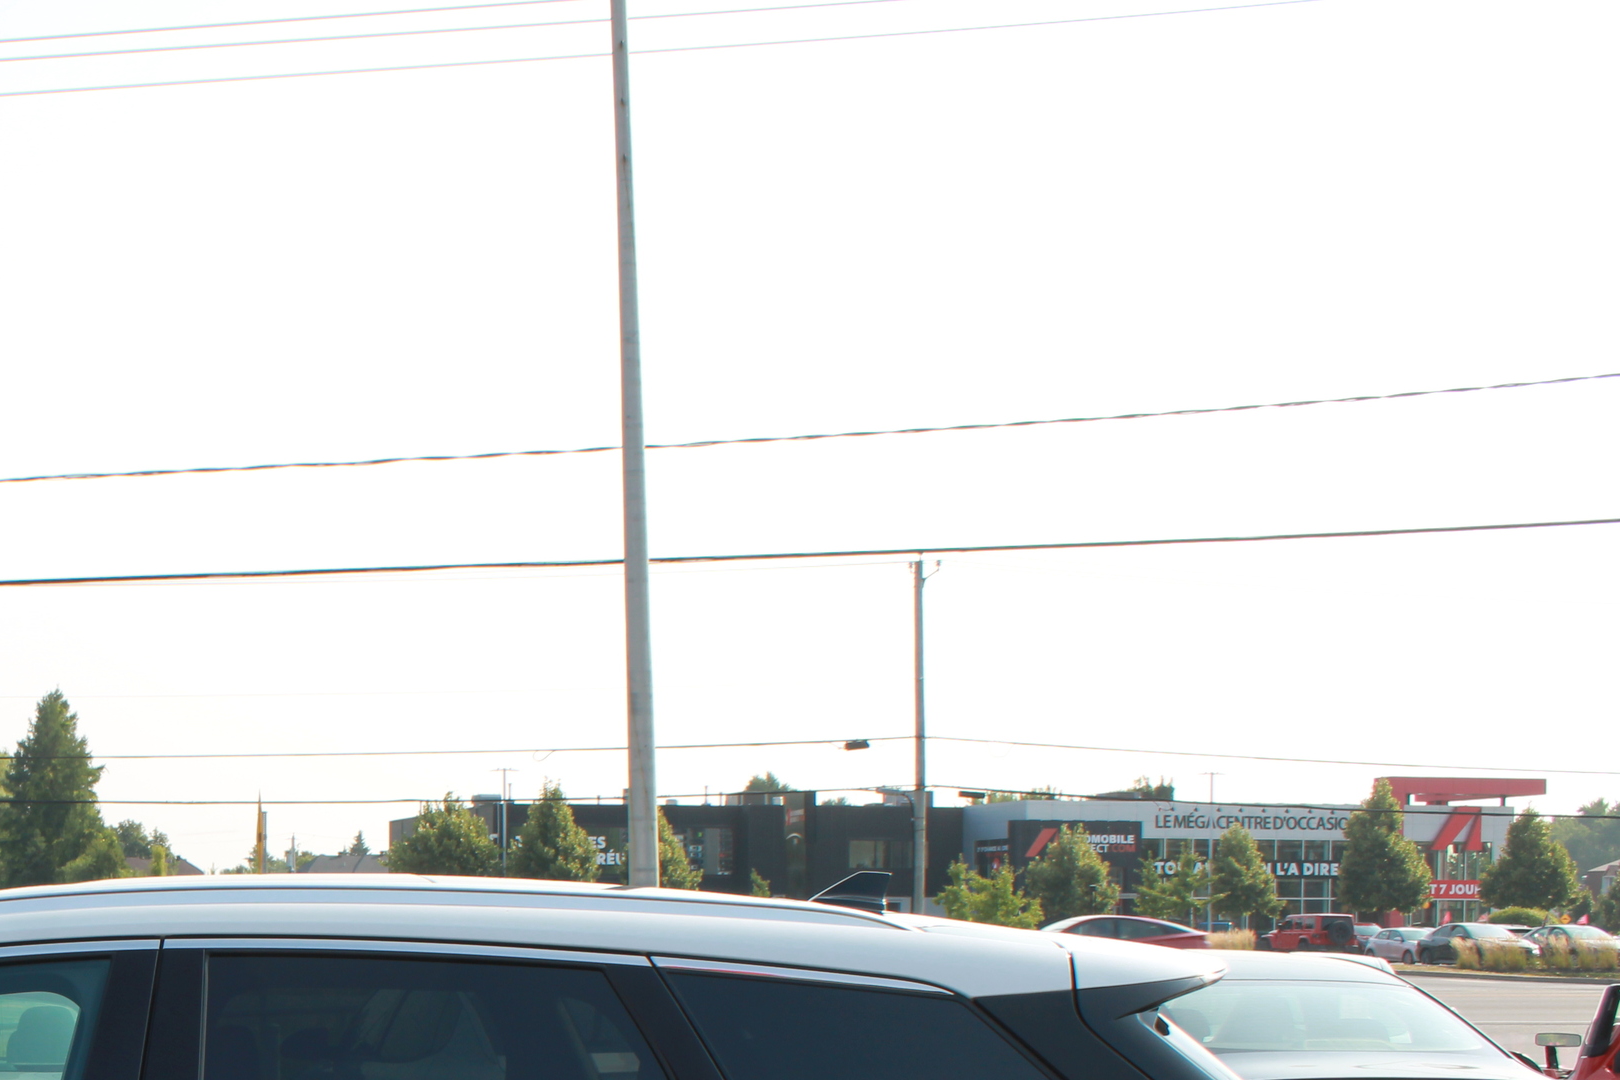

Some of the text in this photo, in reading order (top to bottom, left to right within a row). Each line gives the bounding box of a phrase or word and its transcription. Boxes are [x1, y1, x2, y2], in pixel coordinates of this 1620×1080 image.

[1155, 815, 1172, 829] LE
[1273, 816, 1349, 830] D'OCCASIO
[1302, 862, 1340, 876] DIRE
[1440, 884, 1448, 895] 7
